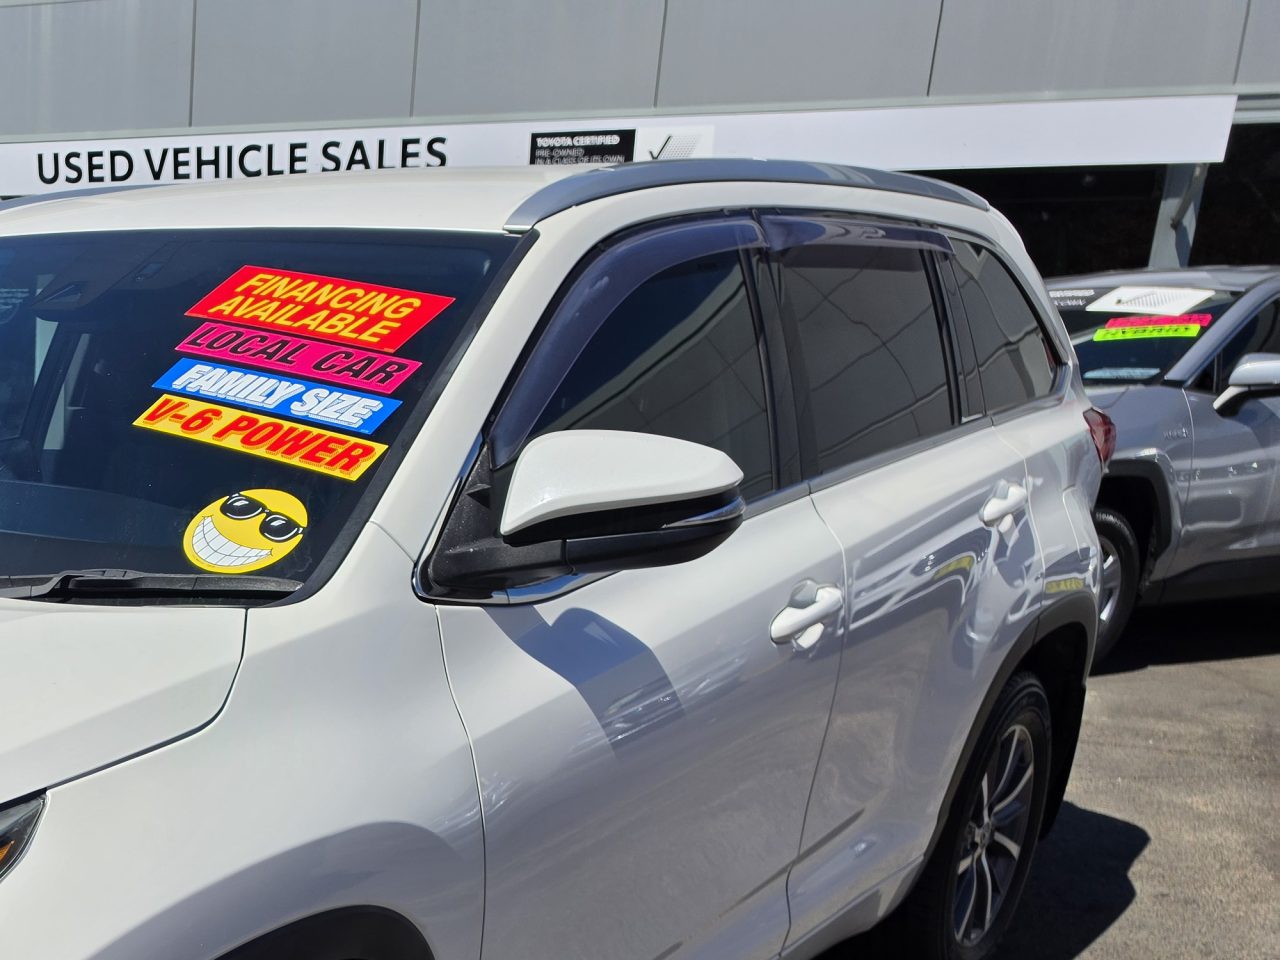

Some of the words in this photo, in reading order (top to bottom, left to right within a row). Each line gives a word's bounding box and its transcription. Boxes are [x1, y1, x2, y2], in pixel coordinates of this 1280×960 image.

[37, 150, 134, 185] USED
[144, 142, 308, 181] VEHICLE
[321, 136, 448, 173] SALES
[536, 136, 573, 148] TOYOTA
[573, 134, 620, 146] CERTIFIED
[208, 296, 401, 342] AVAILABLE
[234, 274, 422, 319] FINANCING
[185, 327, 301, 366] LOCAL
[312, 351, 409, 386] CAR
[172, 364, 306, 408] FAMILY
[290, 388, 384, 429] SIZE
[142, 398, 223, 434] V-6
[211, 415, 376, 476] POWER
